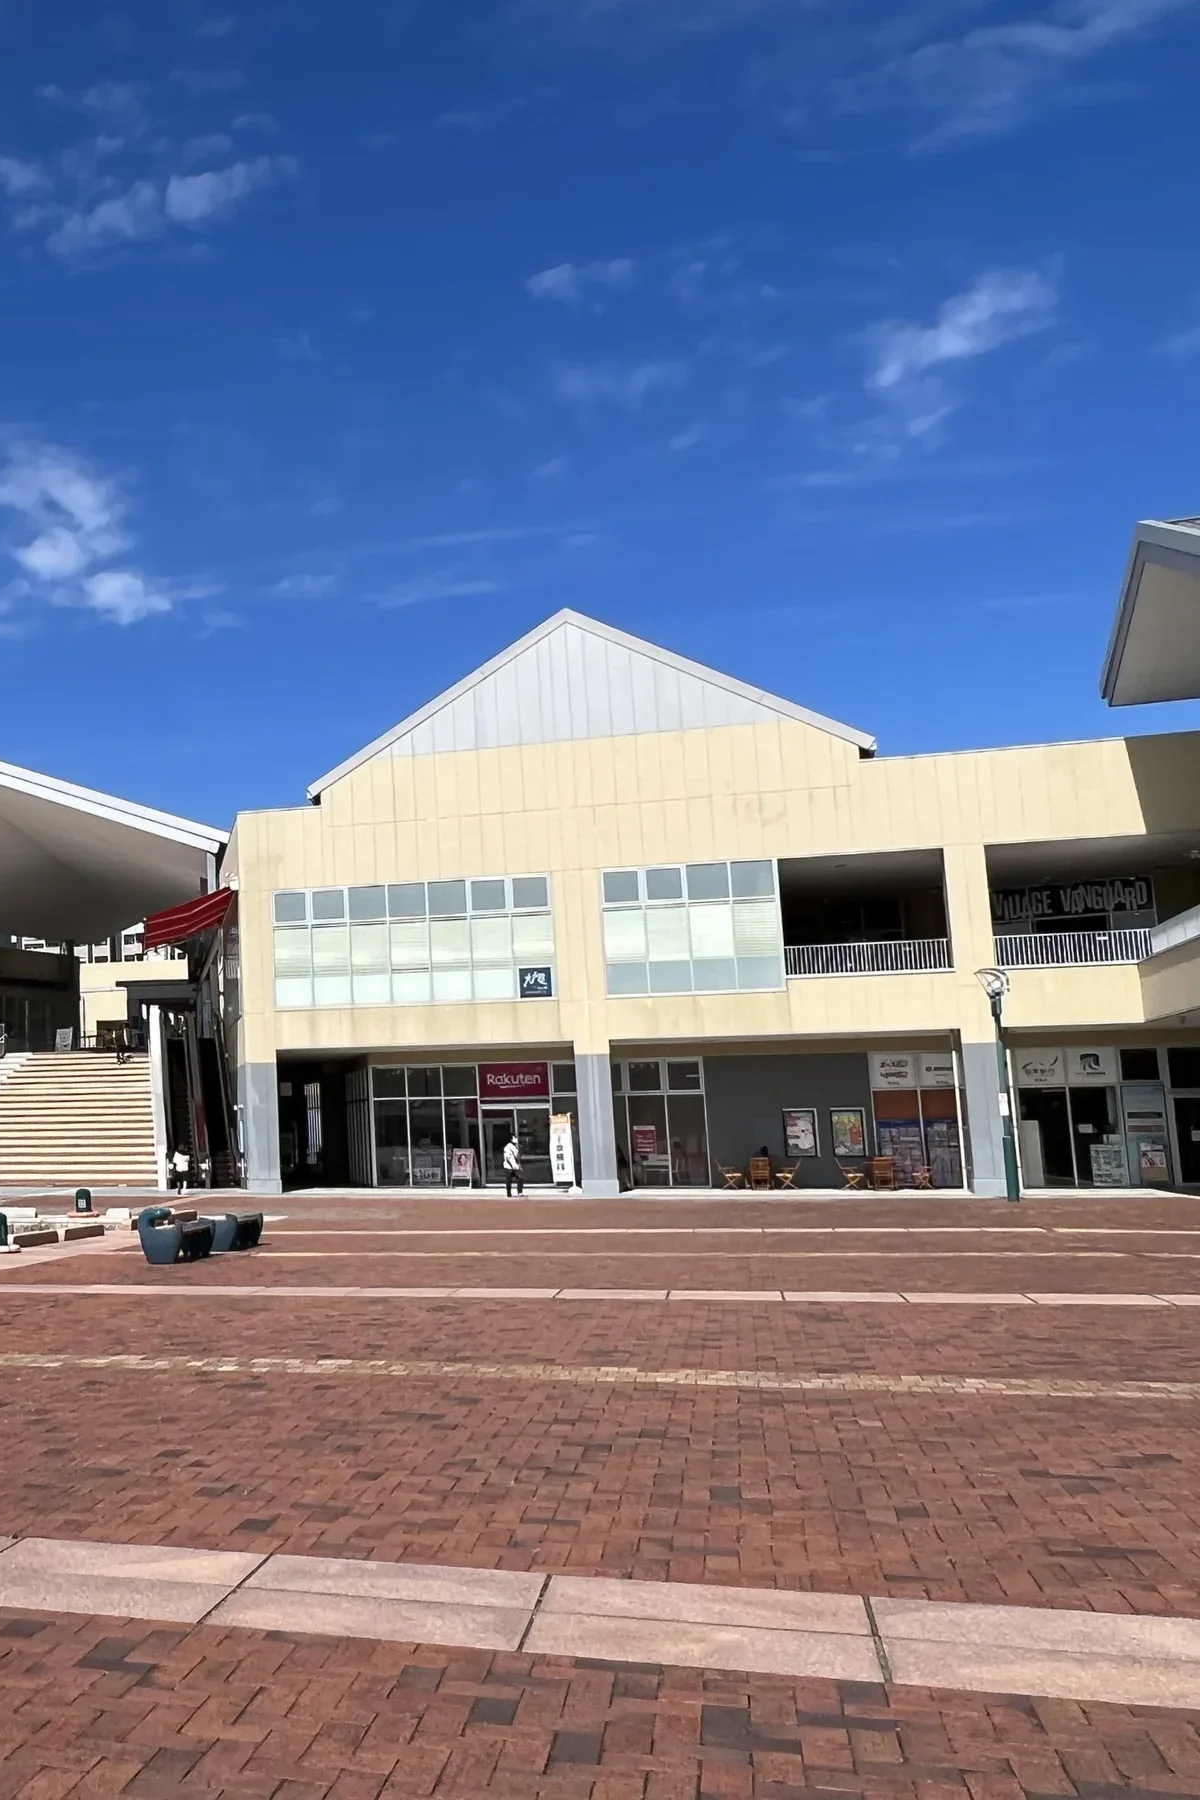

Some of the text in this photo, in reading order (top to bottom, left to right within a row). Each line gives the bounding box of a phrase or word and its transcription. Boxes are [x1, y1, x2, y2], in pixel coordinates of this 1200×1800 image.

[994, 880, 1147, 920] VILLAGE VANGUARD
[486, 1073, 541, 1085] Rakuten
